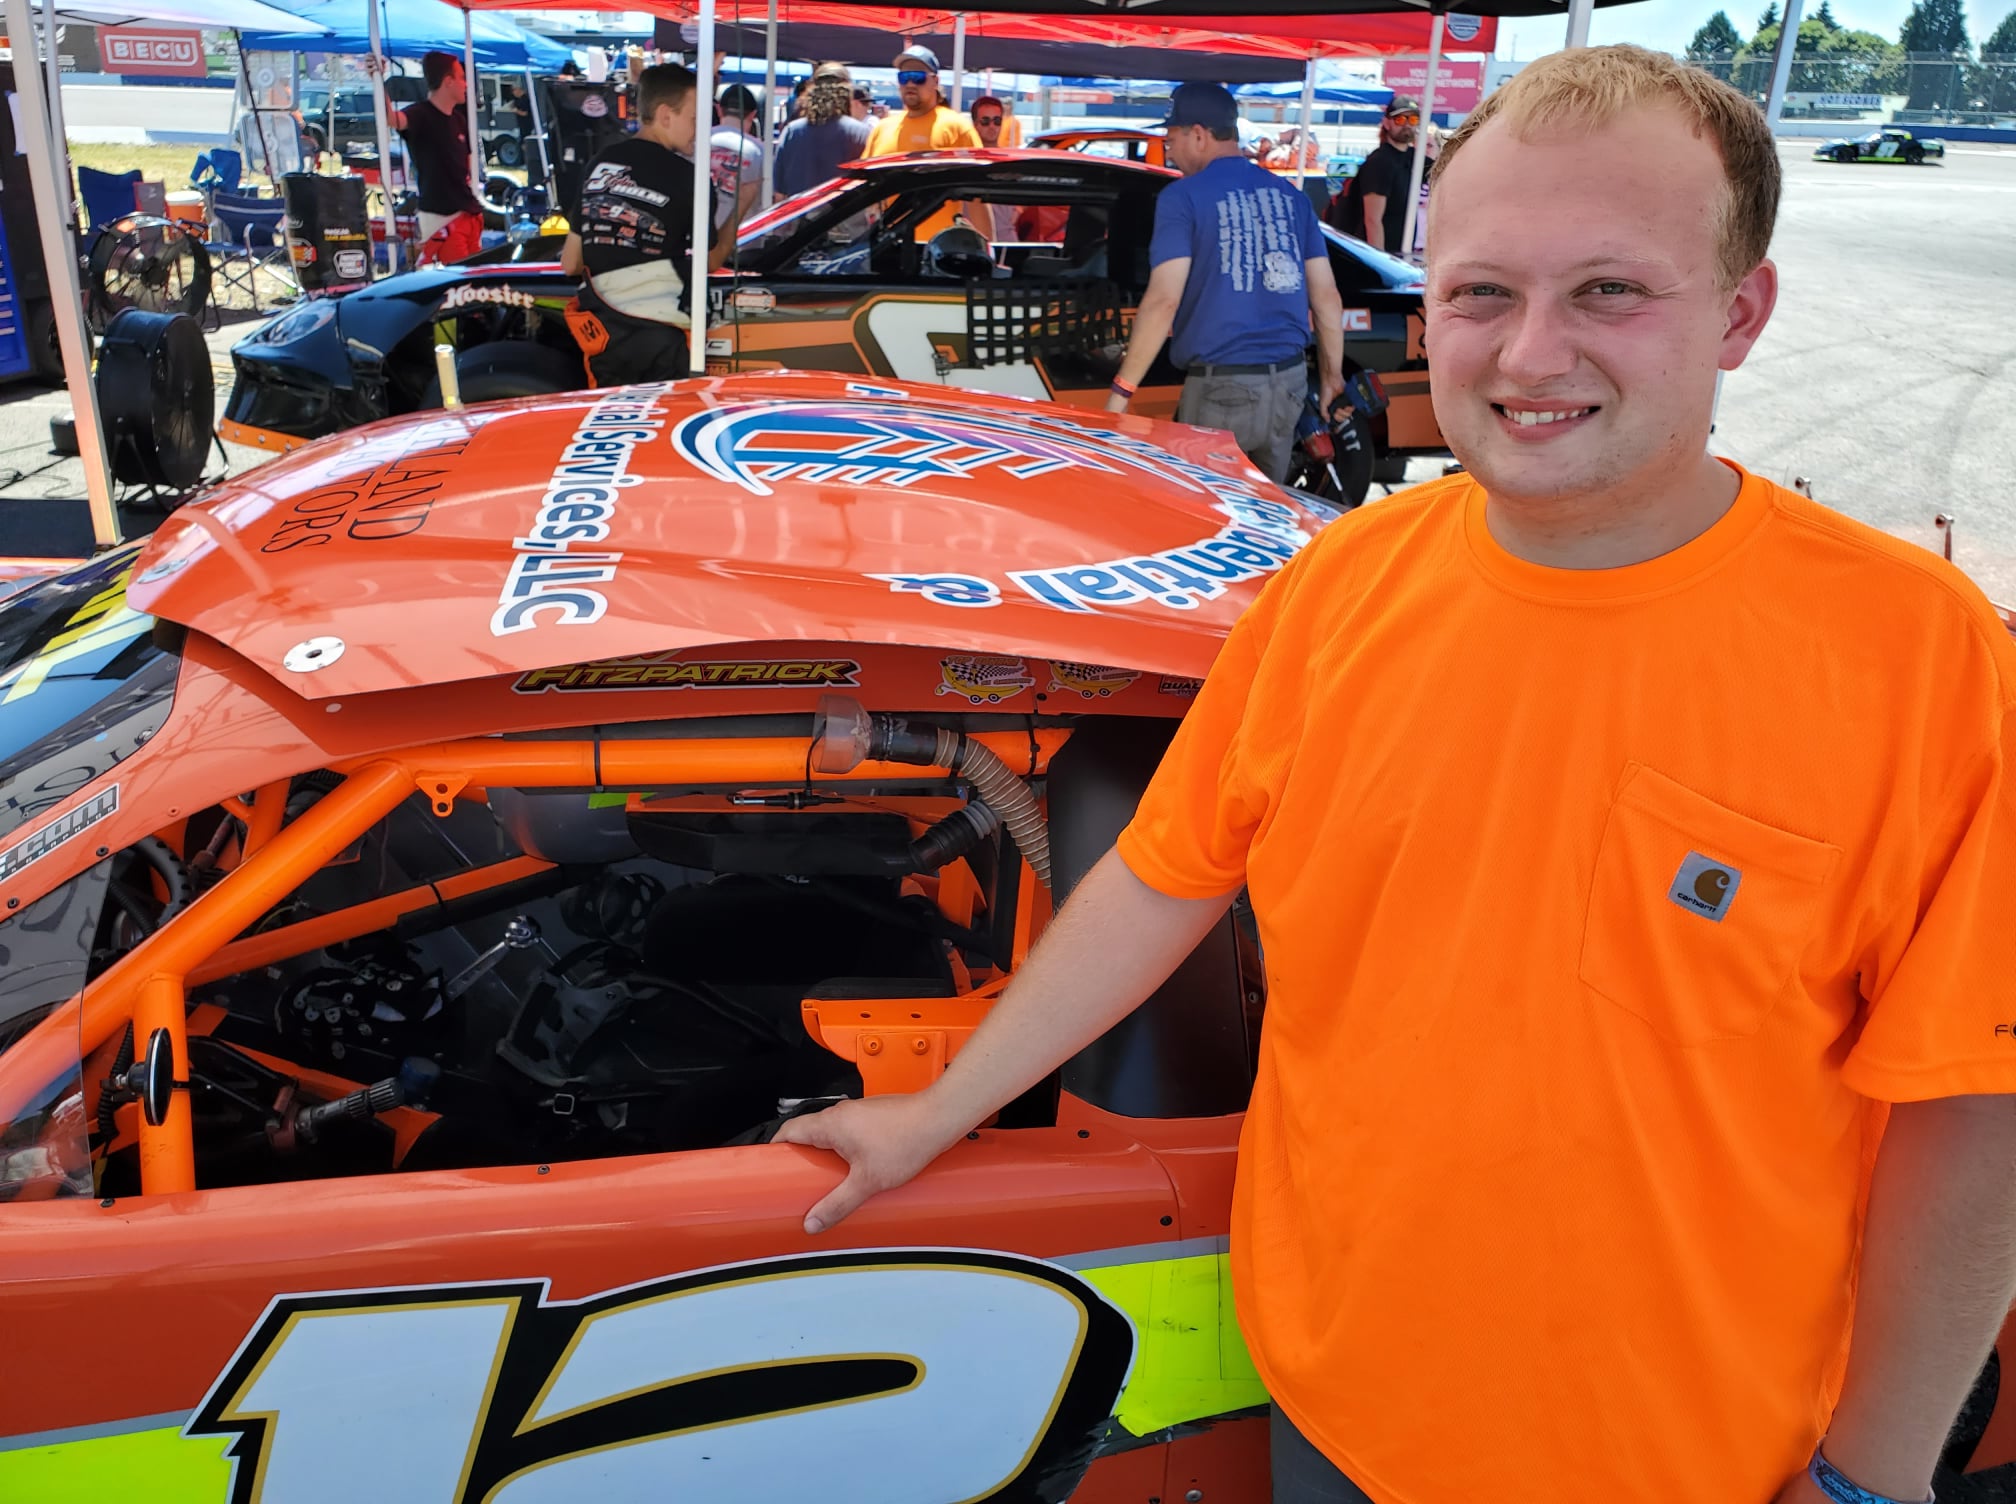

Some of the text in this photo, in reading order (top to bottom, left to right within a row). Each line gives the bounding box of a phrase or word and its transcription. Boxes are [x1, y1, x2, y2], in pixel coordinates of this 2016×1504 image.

[113, 41, 192, 61] BECU
[440, 282, 535, 310] Hoosier
[579, 380, 672, 428] oercial
[513, 427, 664, 550] Services,
[1006, 486, 1308, 612] Residential
[492, 552, 622, 635] LLC
[890, 573, 1000, 607] &
[520, 660, 854, 690] FITZPATRICK
[1677, 892, 1717, 913] carhartt
[190, 1250, 1132, 1504] 12
